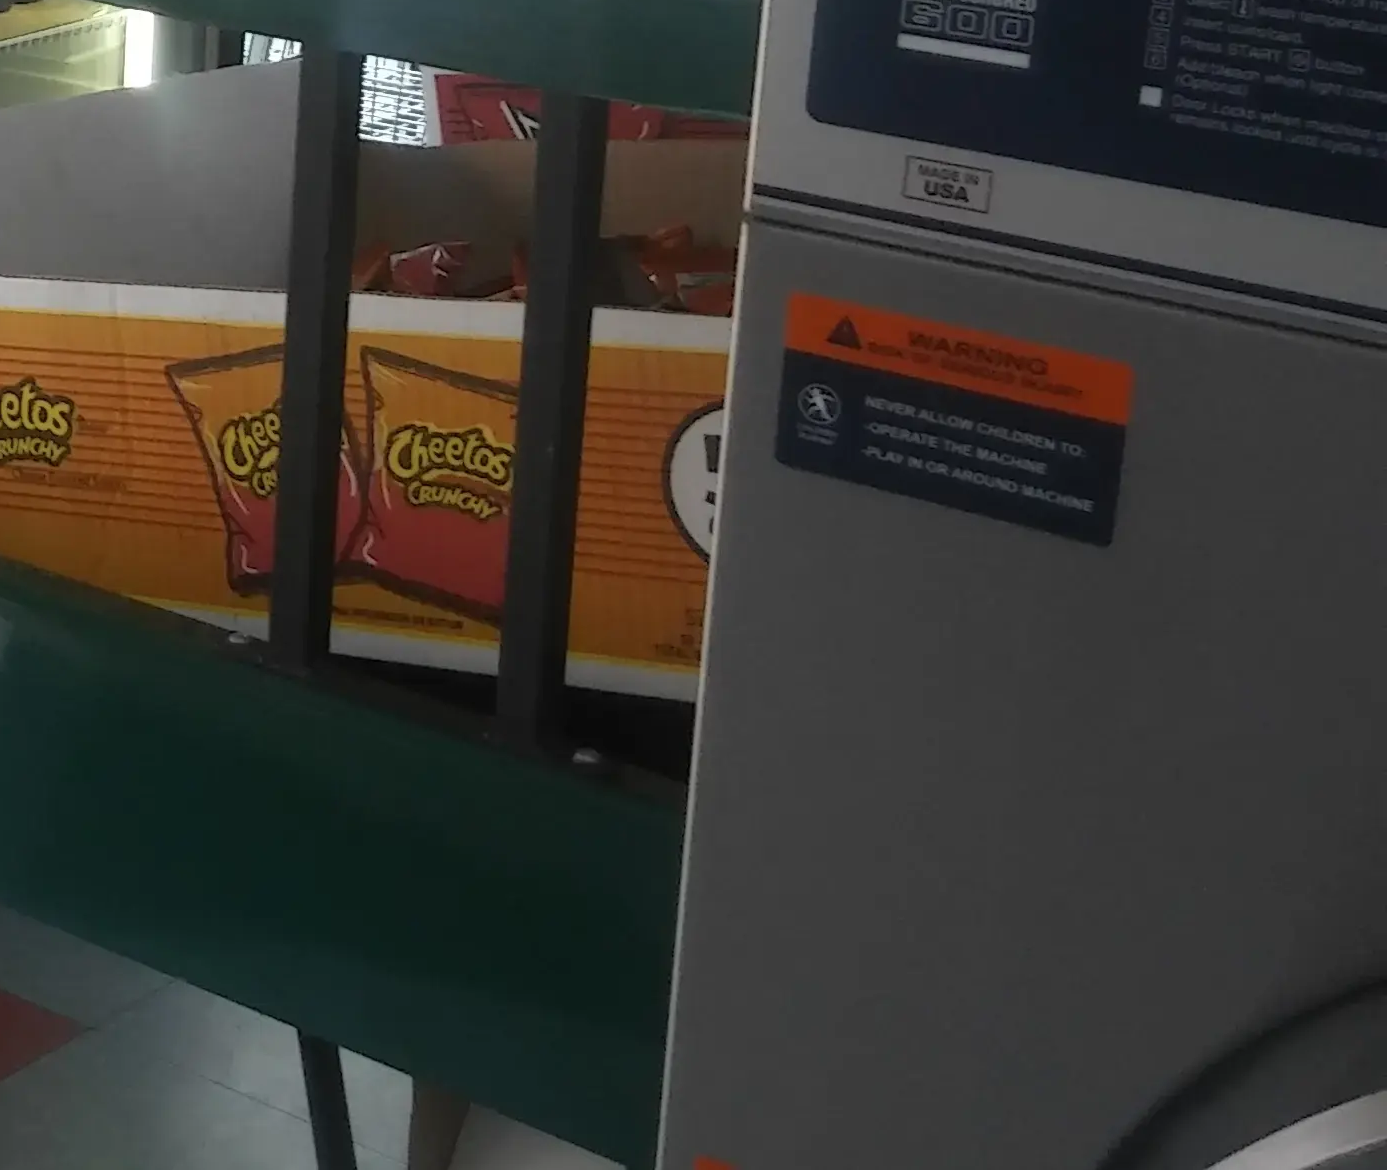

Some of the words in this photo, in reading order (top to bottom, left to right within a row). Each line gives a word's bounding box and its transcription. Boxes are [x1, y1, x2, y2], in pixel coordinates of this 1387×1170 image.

[1228, 42, 1284, 64] START
[924, 180, 970, 203] USA
[908, 329, 1049, 376] WARNING
[221, 411, 282, 477] Chee
[864, 394, 920, 420] NEVER
[919, 407, 974, 431] ALLOW
[976, 421, 1055, 451] CHILDREN
[387, 427, 512, 486] Cheetos
[943, 439, 973, 458] THE
[976, 446, 1047, 475] MACHINE
[407, 480, 502, 519] CRUNCHY
[907, 455, 924, 469] IN
[951, 465, 1020, 492] AROUND
[1020, 481, 1095, 514] MACHINE
